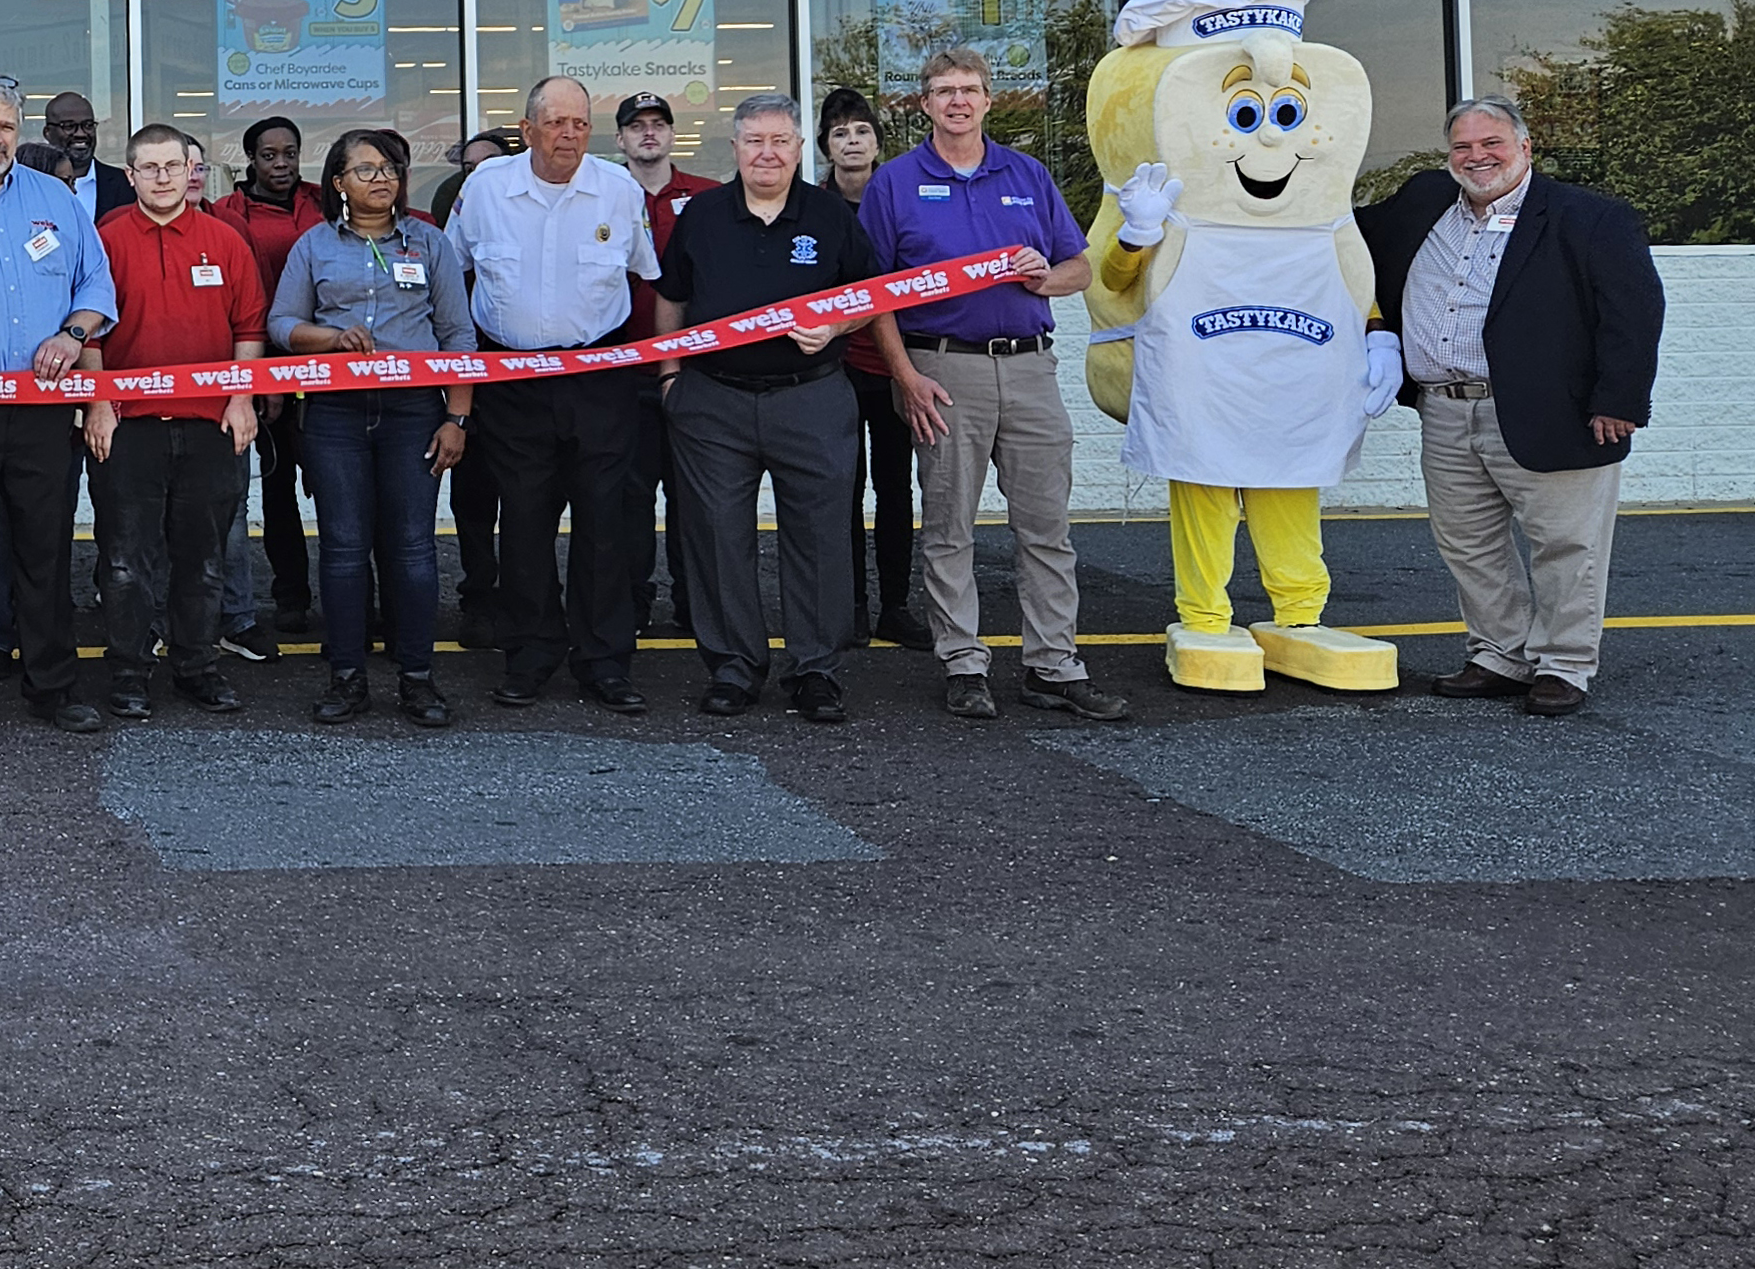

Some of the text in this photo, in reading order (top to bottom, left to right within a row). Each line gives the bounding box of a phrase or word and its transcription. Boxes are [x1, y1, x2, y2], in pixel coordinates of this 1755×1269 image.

[255, 63, 347, 78] Chef Boyardee
[556, 60, 707, 80] Tastykake Snacks
[884, 71, 921, 83] Roun
[224, 78, 380, 92] Cans or Microwave Cups
[885, 269, 948, 296] weis
[807, 288, 872, 314] weis
[729, 307, 794, 333] weis
[1198, 309, 1326, 340] TASTYKAKE
[653, 330, 716, 352] weis
[348, 354, 410, 376] weis
[426, 355, 485, 373] weis
[501, 354, 562, 370] weis
[576, 346, 639, 364] weis
[114, 371, 174, 391] weis
[192, 366, 253, 386] weis
[269, 360, 331, 382] weis
[35, 373, 95, 392] weis
